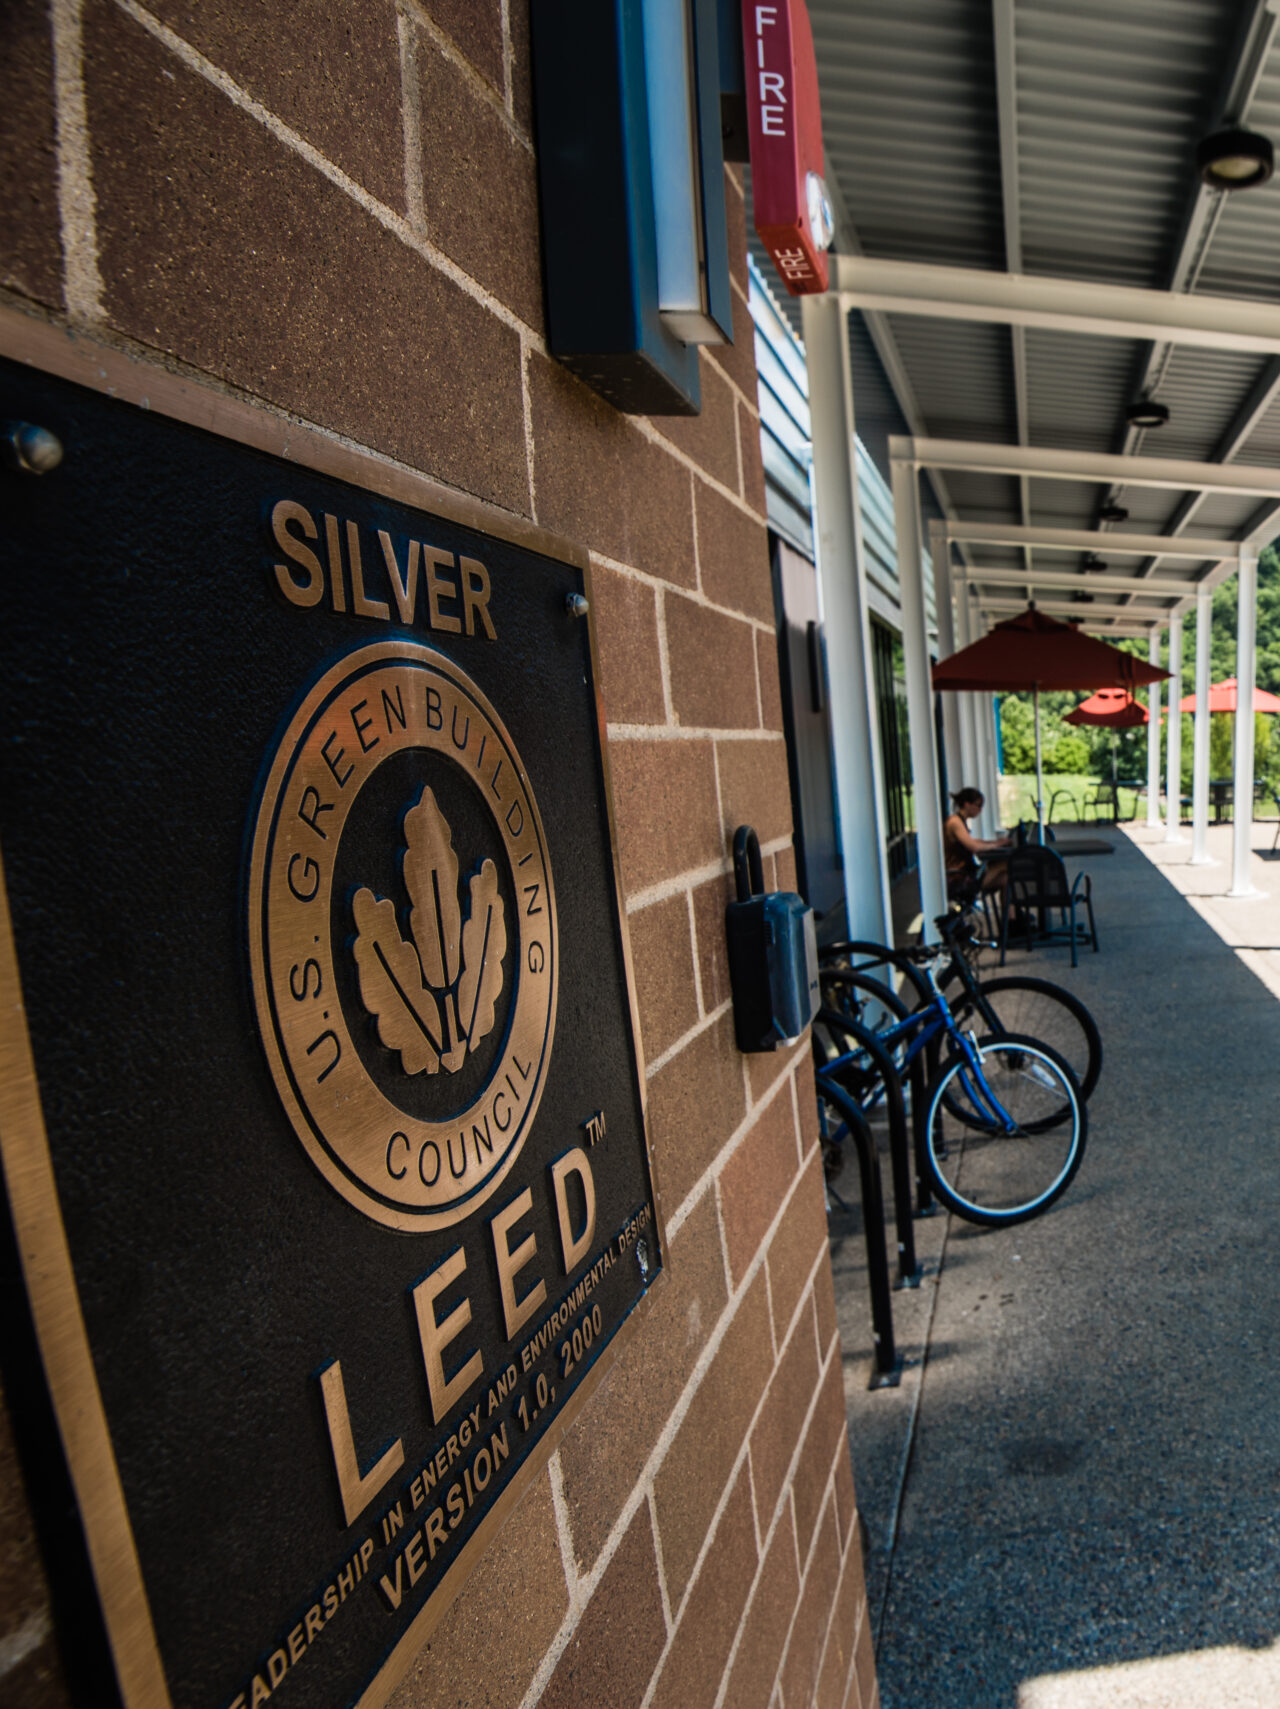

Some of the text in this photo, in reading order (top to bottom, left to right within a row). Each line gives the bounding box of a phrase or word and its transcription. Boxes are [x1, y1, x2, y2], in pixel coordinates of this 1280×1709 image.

[755, 6, 787, 136] FIRE
[775, 247, 814, 280] FIRE
[271, 500, 498, 641] SILVER
[287, 686, 545, 1187] U.S. GREEN BUILDING COUNCIL
[319, 1147, 596, 1528] LEED
[379, 1304, 602, 1610] VERSION 1.0, 2000
[381, 1501, 404, 1546] IN
[409, 1403, 480, 1511] ENERGY
[488, 1364, 517, 1416] AND
[521, 1251, 617, 1366] ENVIRONMENTAL
[618, 1202, 652, 1253] DESIGN
